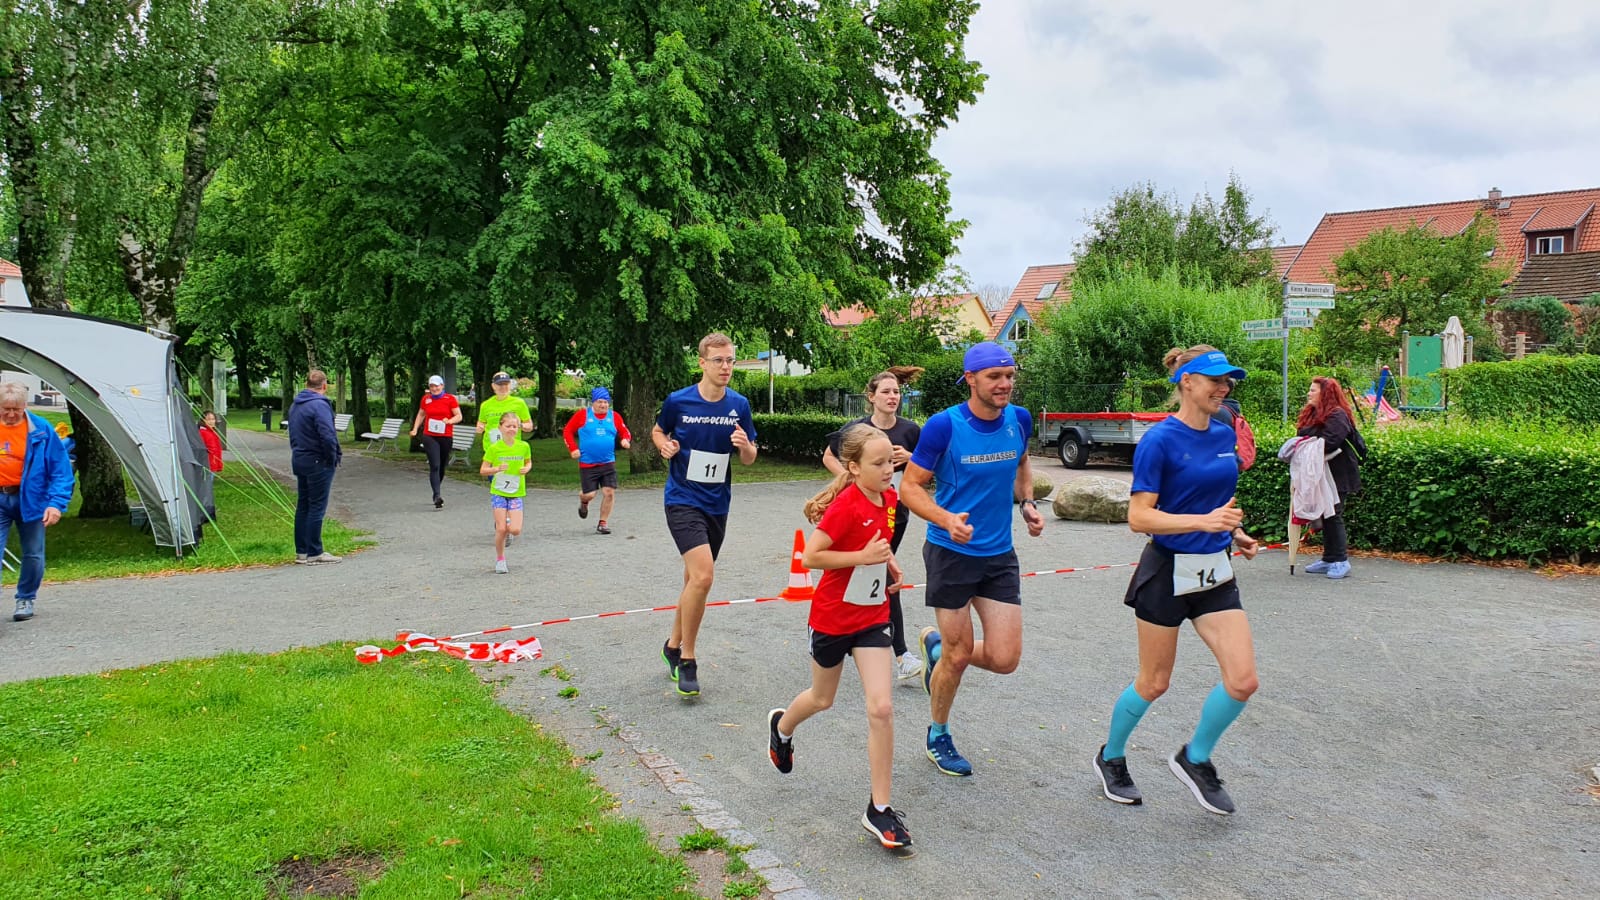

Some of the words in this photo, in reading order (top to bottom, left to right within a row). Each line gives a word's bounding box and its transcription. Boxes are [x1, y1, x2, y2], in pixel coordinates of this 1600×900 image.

[704, 463, 717, 478] 11
[503, 480, 511, 489] 7
[1196, 567, 1217, 588] 14
[869, 578, 881, 598] 2
